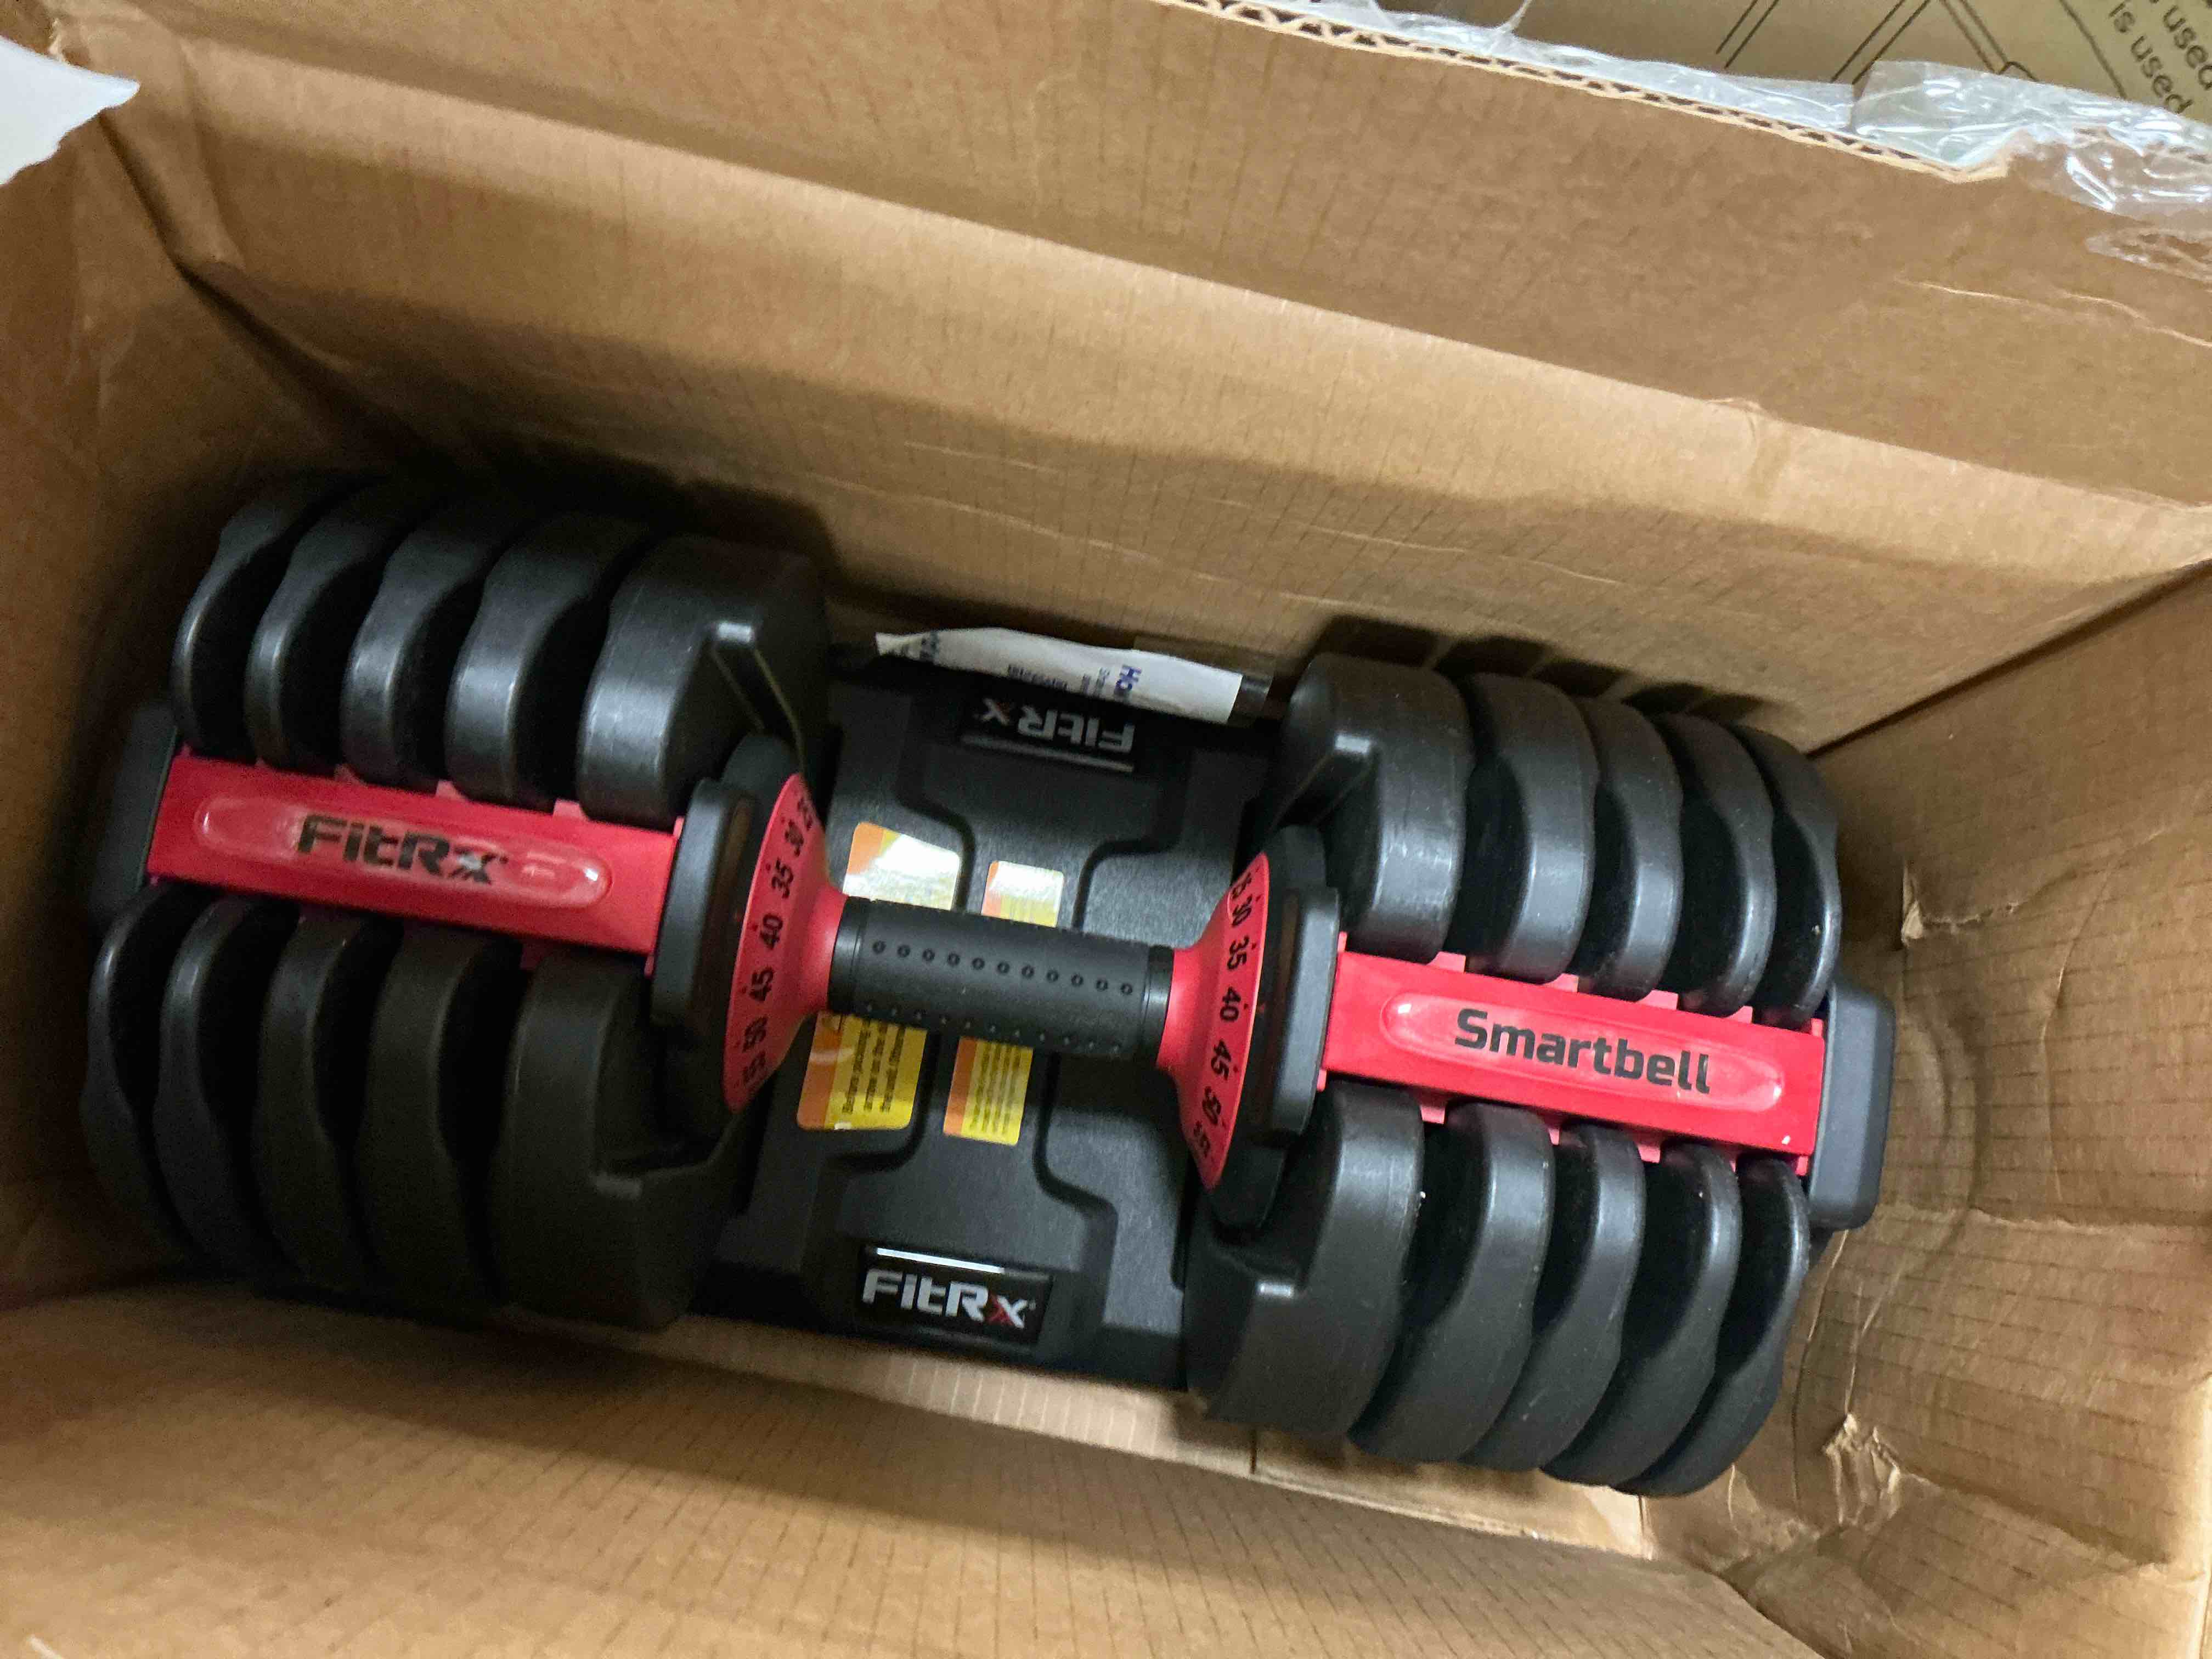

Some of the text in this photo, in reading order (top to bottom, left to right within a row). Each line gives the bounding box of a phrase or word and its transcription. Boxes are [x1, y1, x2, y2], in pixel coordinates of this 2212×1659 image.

[2109, 0, 2194, 114] is used
[771, 860, 794, 899] 35
[1231, 896, 1253, 927] 30
[759, 913, 782, 950] 40
[1227, 935, 1249, 970] 35
[749, 967, 774, 1003] 45
[1220, 986, 1241, 1022] 40
[1210, 1040, 1232, 1081] 45
[1454, 1008, 1711, 1094] Smartbell
